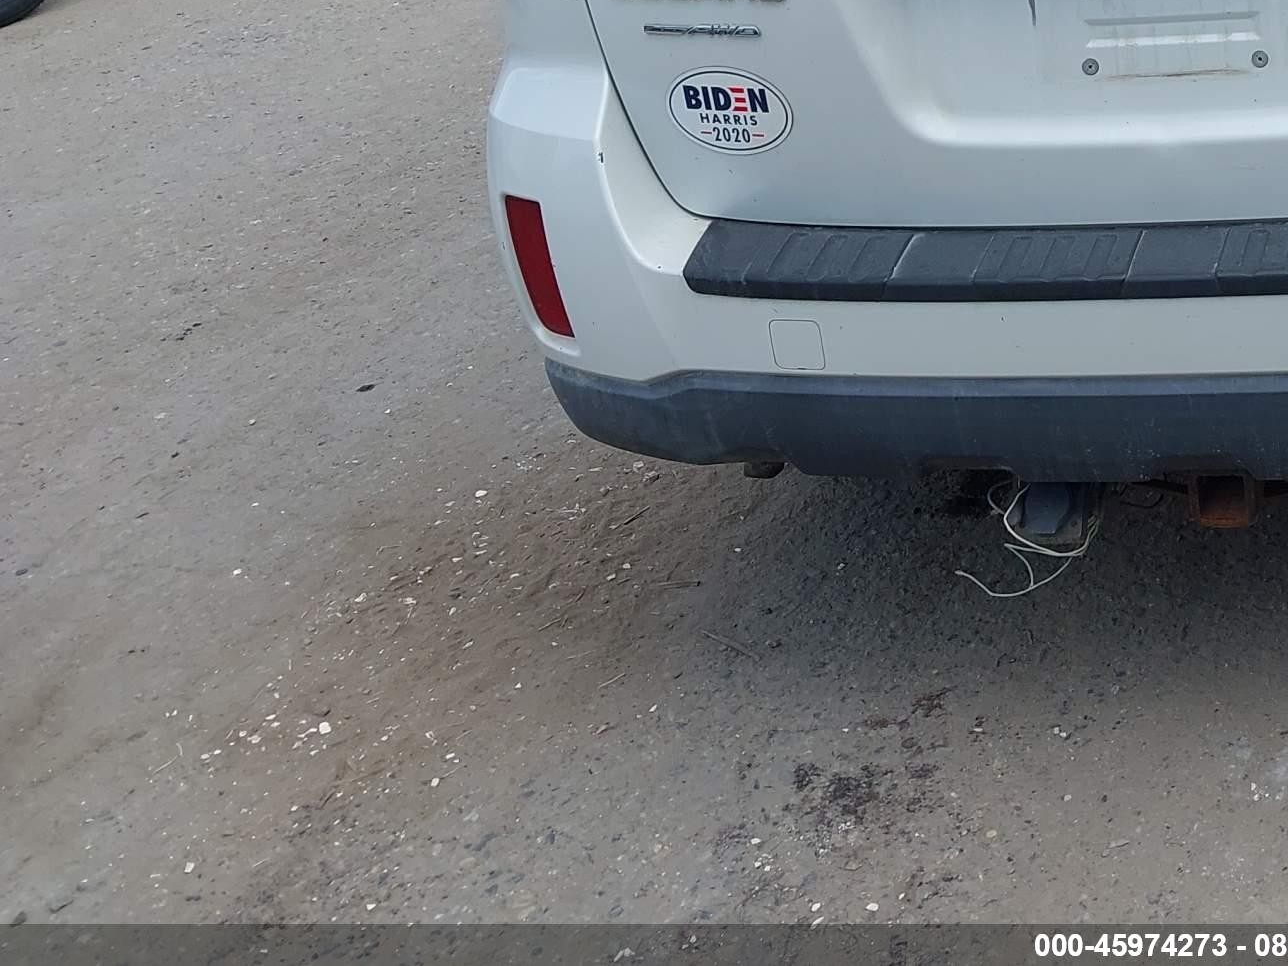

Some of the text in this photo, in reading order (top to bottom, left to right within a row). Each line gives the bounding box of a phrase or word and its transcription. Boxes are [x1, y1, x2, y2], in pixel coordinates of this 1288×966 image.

[682, 84, 770, 114] BIDEN
[699, 112, 759, 127] HARRIS
[712, 127, 751, 144] 2020
